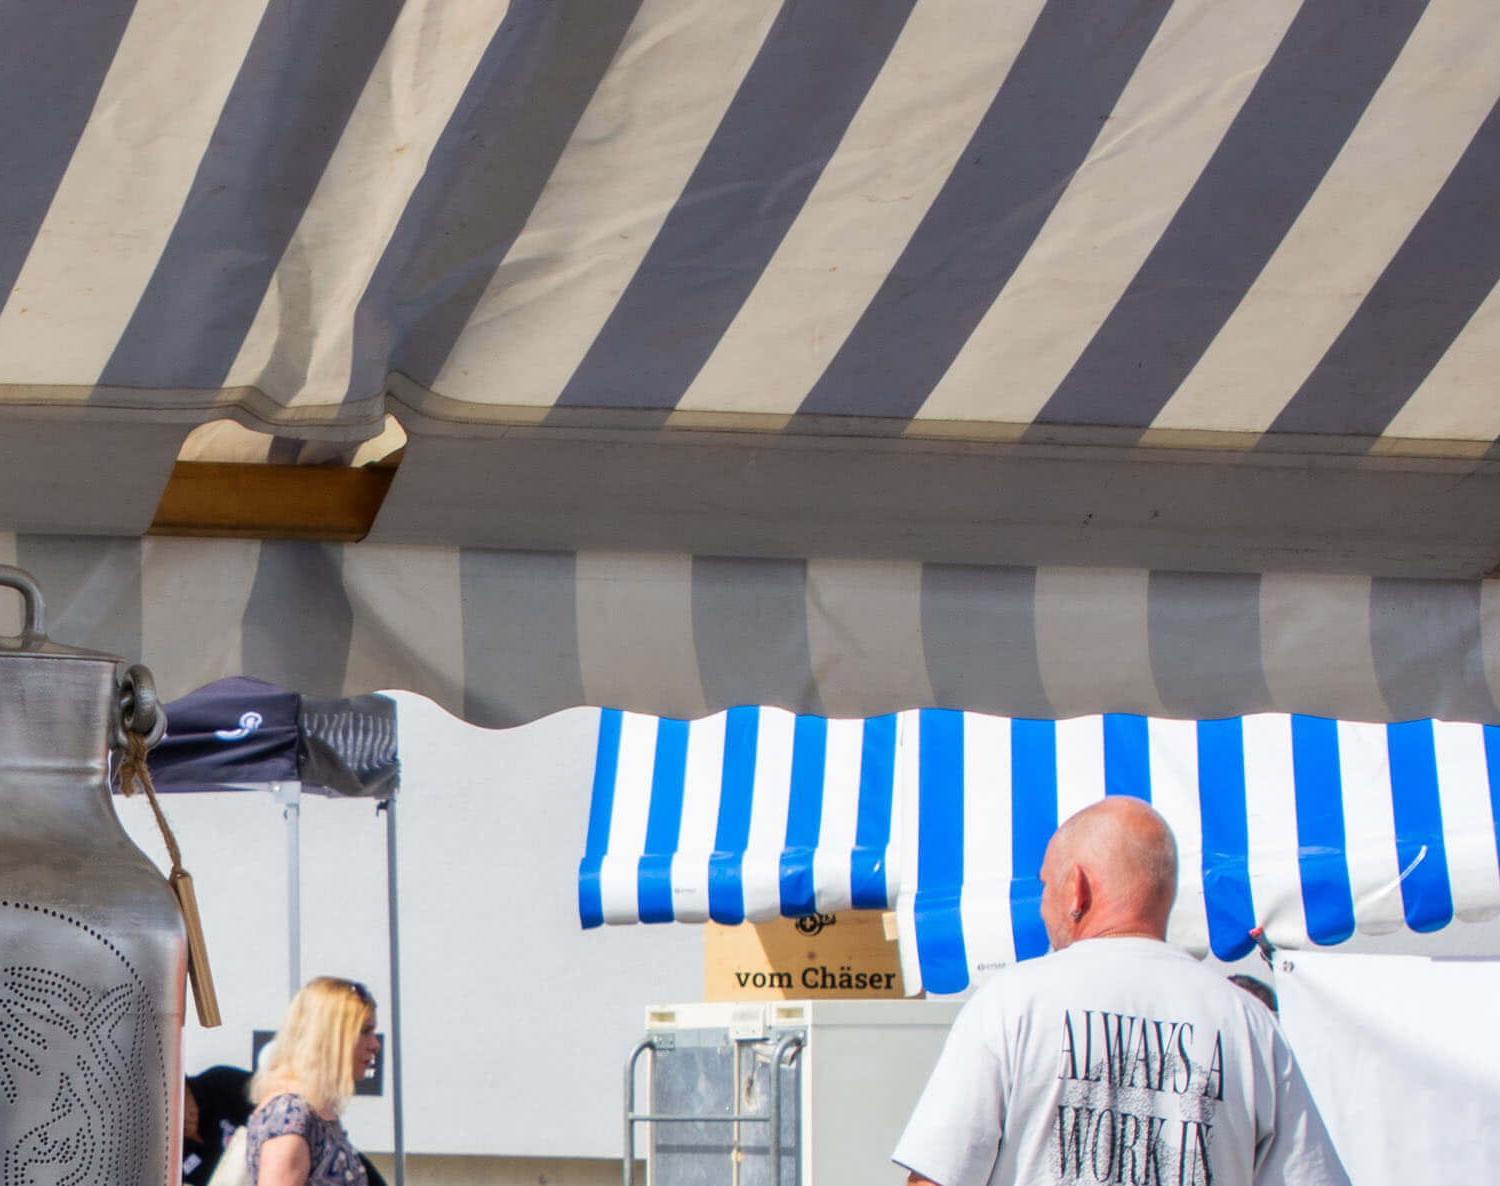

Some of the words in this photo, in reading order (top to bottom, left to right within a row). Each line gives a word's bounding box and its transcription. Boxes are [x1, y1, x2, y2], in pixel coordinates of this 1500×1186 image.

[736, 971, 793, 988] vom
[801, 965, 896, 989] Chäser
[1058, 1008, 1194, 1095] ALWAYS
[1203, 1029, 1225, 1101] A
